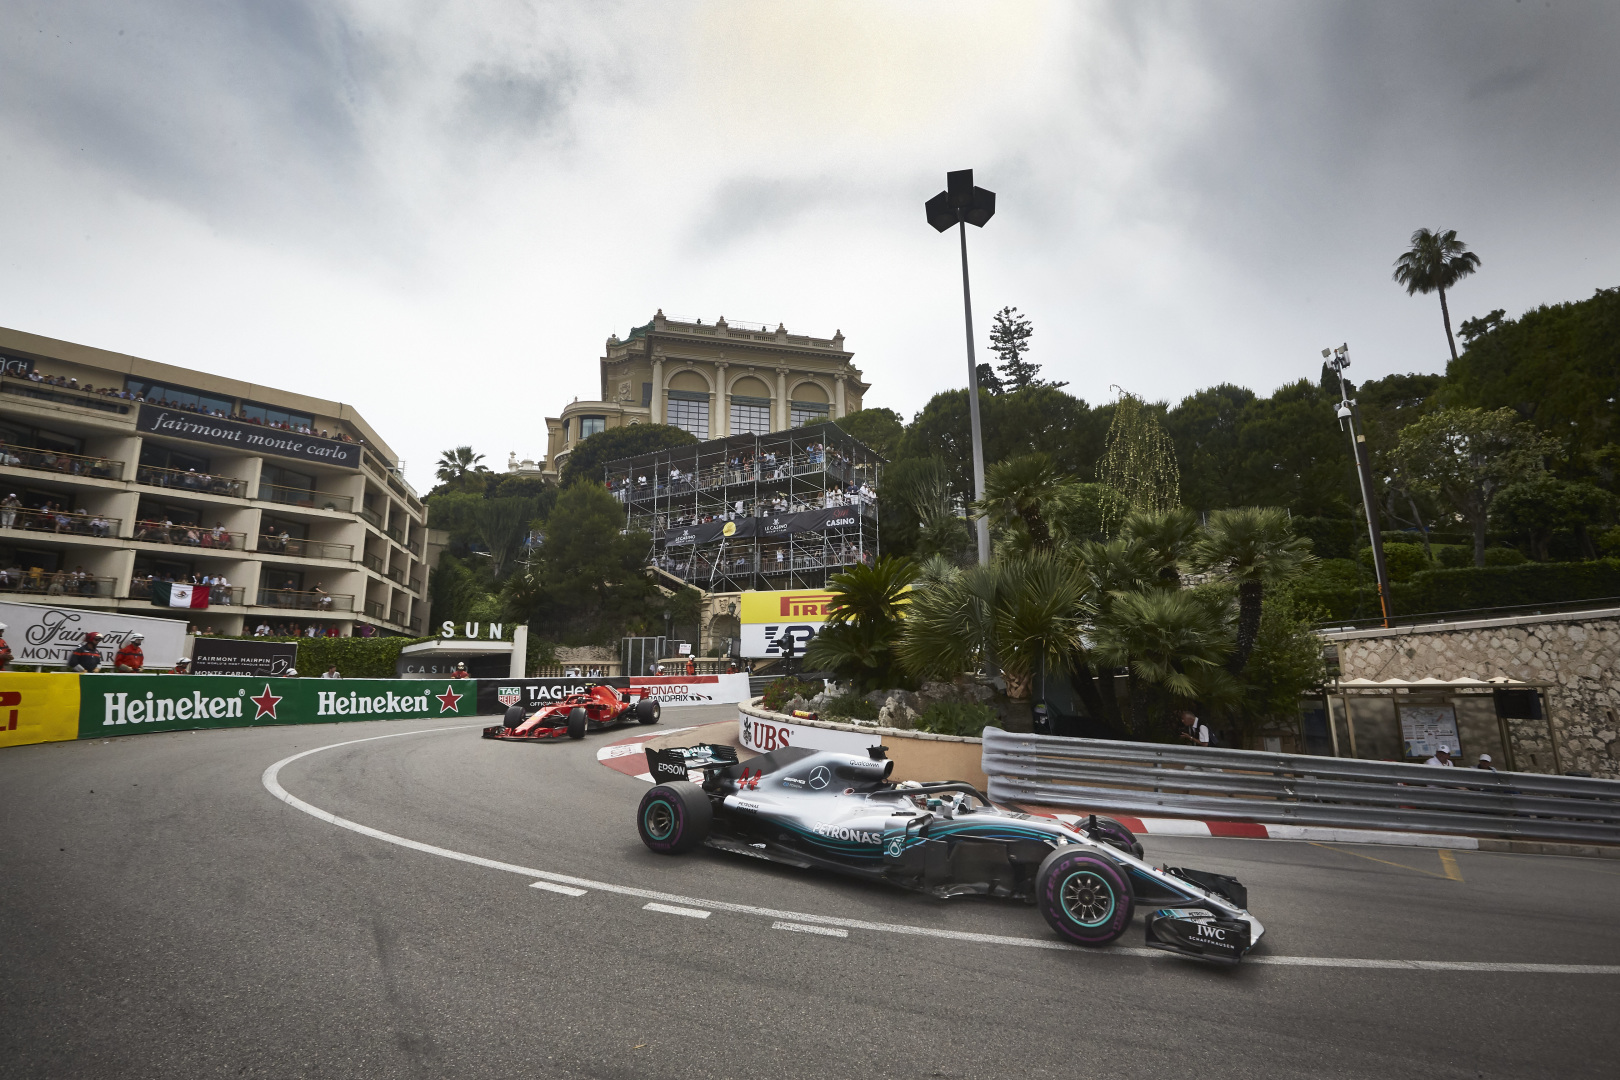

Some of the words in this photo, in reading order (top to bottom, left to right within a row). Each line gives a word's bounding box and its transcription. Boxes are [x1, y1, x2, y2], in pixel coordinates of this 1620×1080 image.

[151, 412, 242, 441] fairmont
[247, 434, 303, 452] monte
[306, 446, 348, 460] carlo
[826, 518, 855, 527] CASINO
[441, 620, 503, 639] SUN
[20, 647, 73, 661] MONT
[102, 690, 243, 725] Heineken
[317, 691, 429, 716] Heineken
[753, 722, 790, 751] UBS
[658, 763, 685, 776] EPSON
[850, 760, 880, 768] Qualcomm
[737, 767, 762, 791] 44
[738, 801, 760, 809] PETRONAS
[811, 821, 883, 845] PETRONAS
[1046, 860, 1070, 902] ZERO
[1197, 924, 1226, 941] IWC
[1188, 935, 1235, 950] SCHAFFHAUSEN
